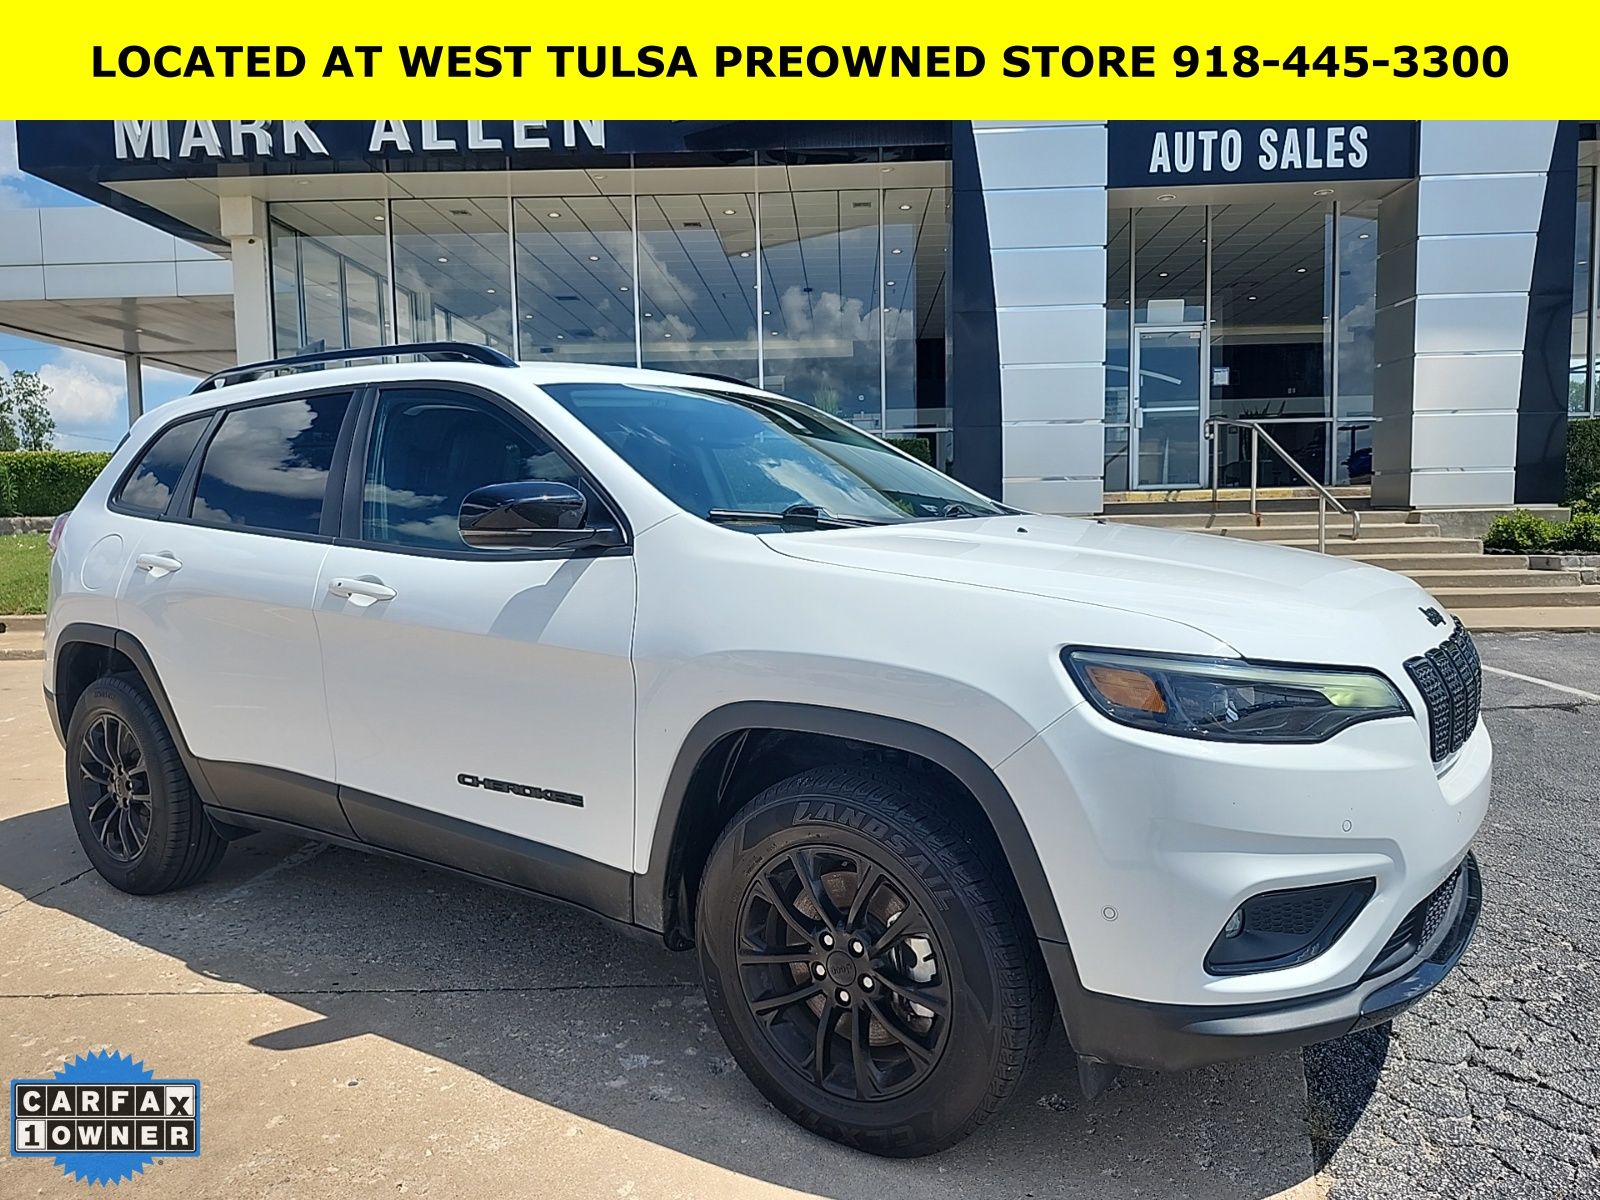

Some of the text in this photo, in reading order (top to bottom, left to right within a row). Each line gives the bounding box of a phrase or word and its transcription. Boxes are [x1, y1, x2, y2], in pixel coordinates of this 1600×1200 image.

[113, 120, 606, 160] MARK ALLEN
[1149, 125, 1368, 173] AUTO SALES
[457, 773, 585, 808] CHEROKEE
